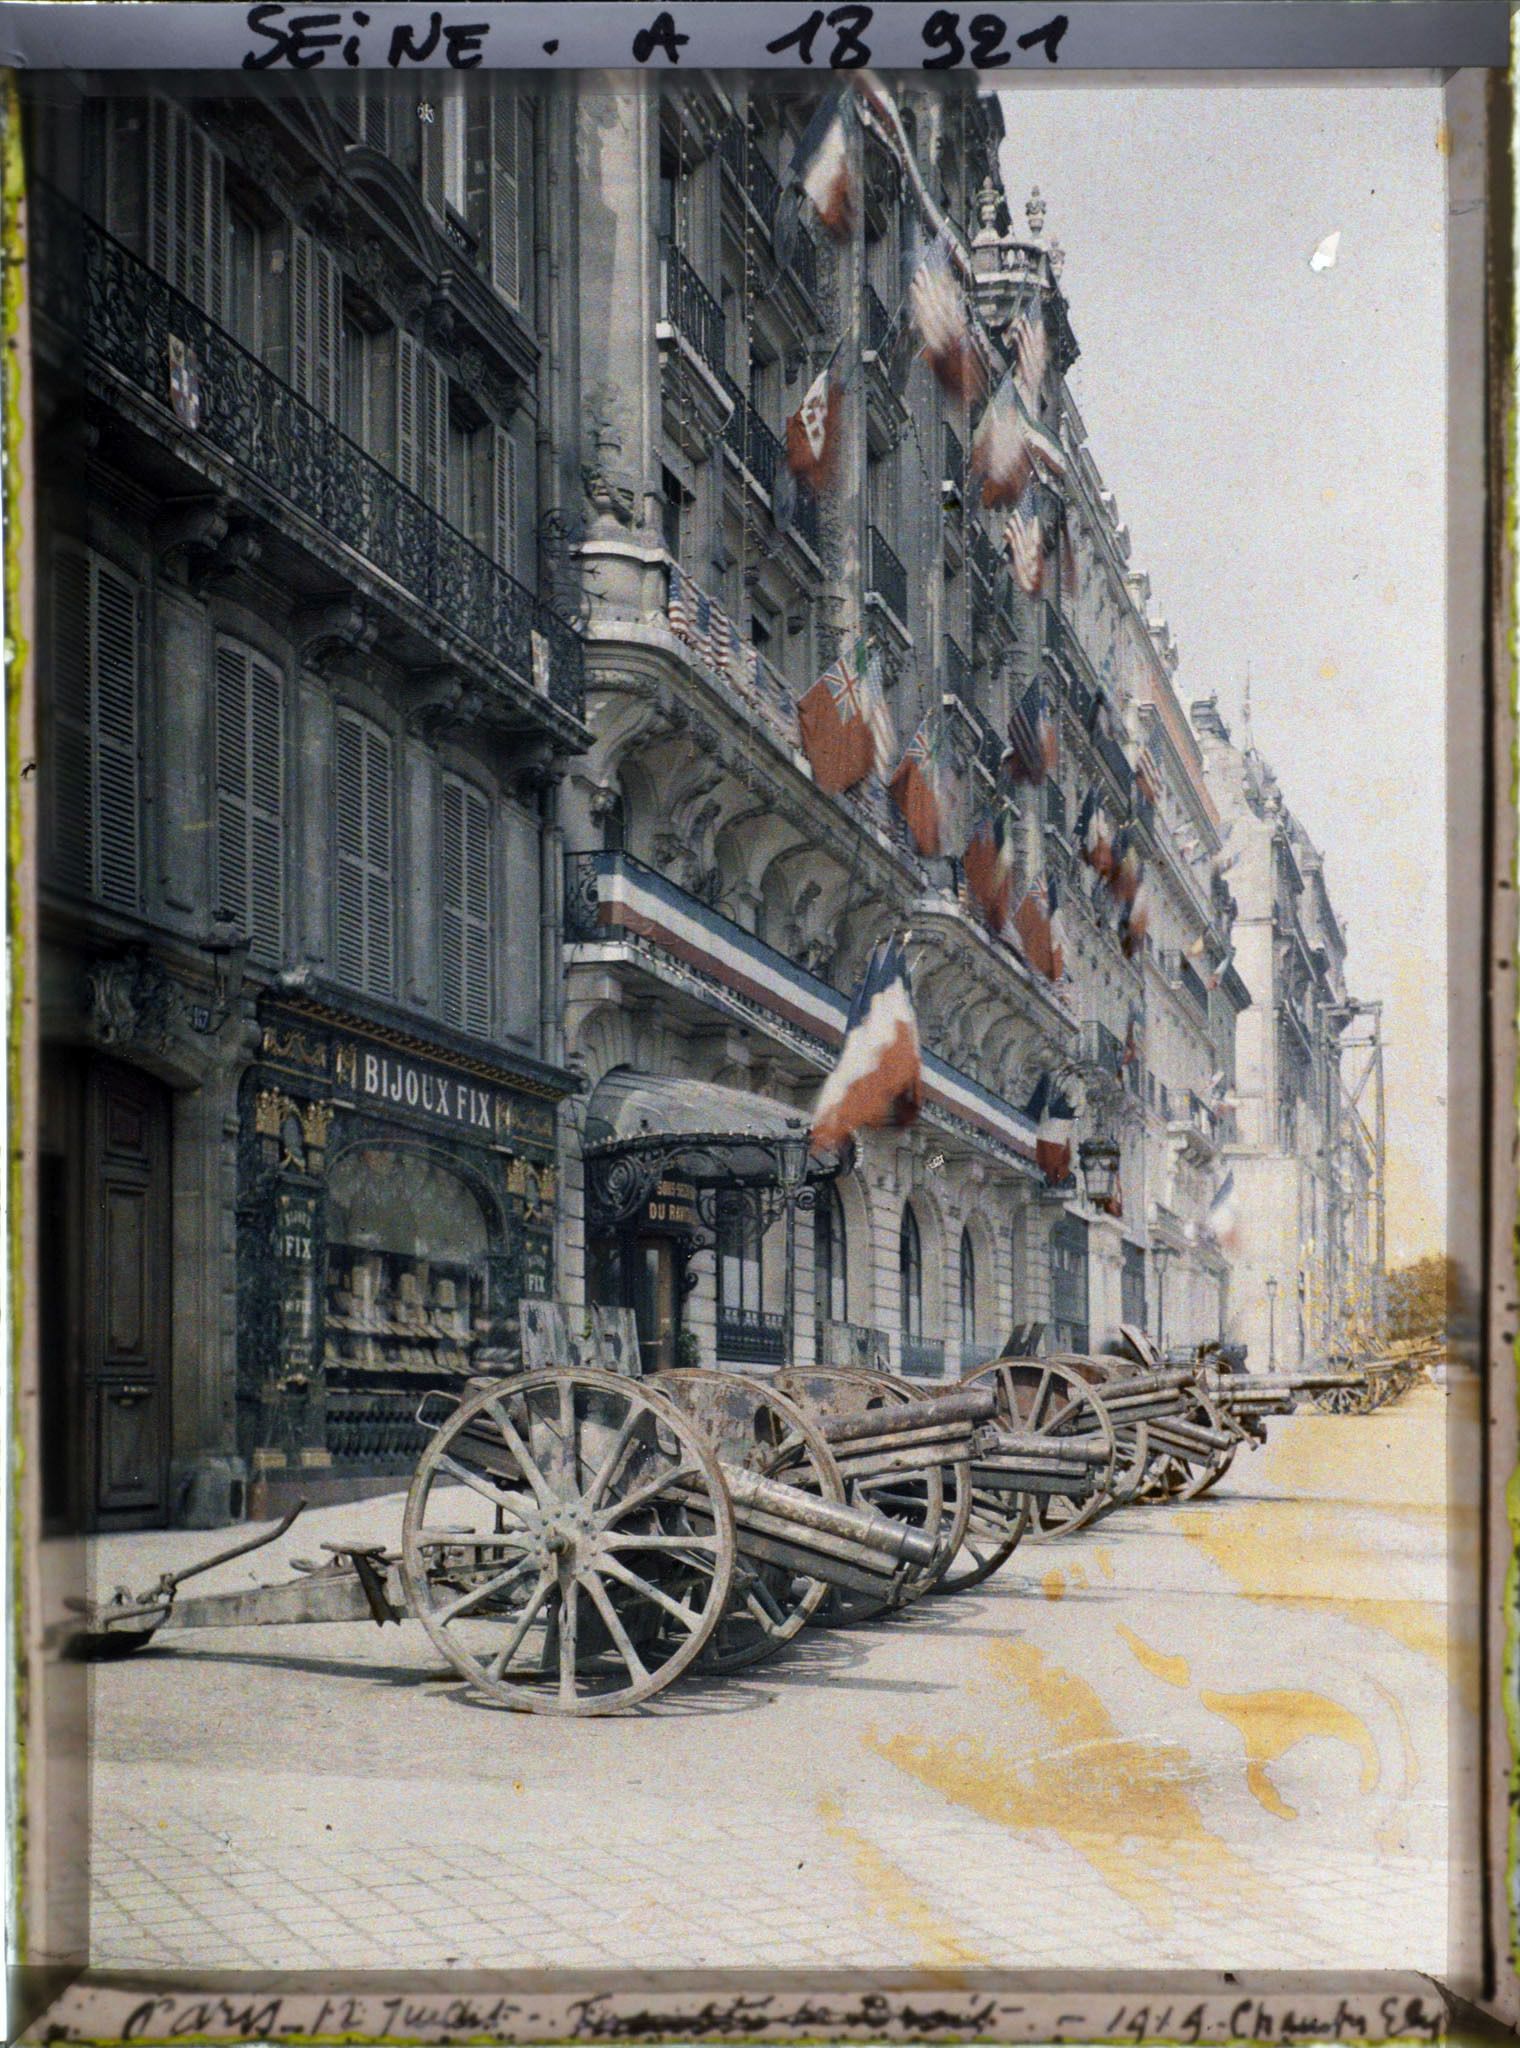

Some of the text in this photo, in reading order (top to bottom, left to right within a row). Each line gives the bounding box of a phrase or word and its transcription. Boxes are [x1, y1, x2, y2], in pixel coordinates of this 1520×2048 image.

[632, 11, 690, 64] A
[766, 5, 873, 69] 18
[922, 10, 1068, 69] 921
[365, 1053, 491, 1129] BIJOUX FIX
[648, 1202, 666, 1220] DU
[285, 1235, 312, 1259] FIX
